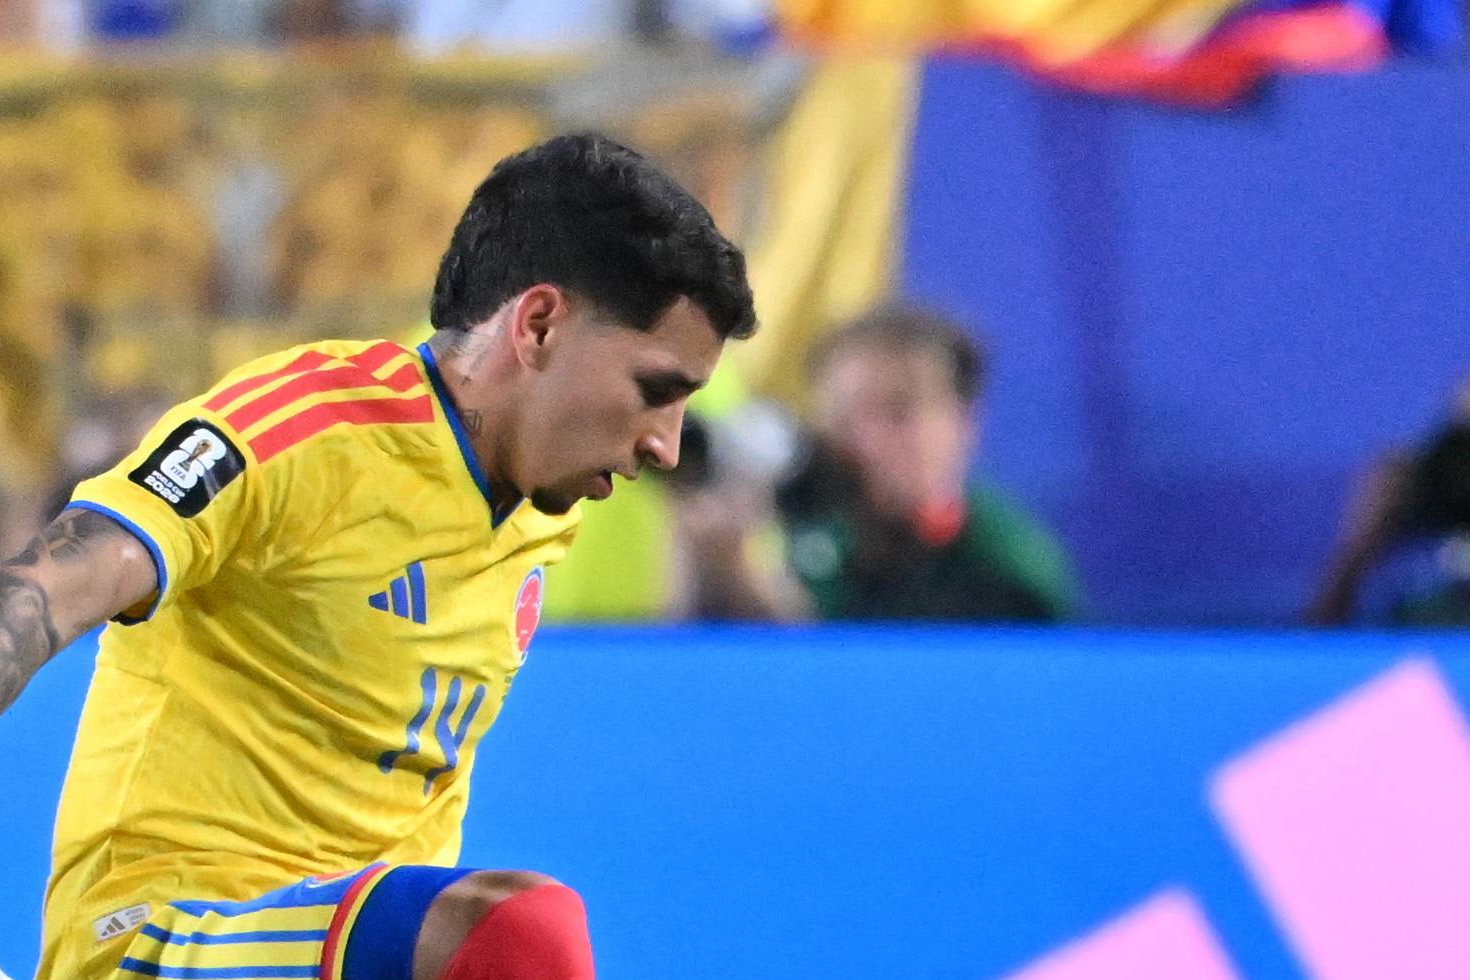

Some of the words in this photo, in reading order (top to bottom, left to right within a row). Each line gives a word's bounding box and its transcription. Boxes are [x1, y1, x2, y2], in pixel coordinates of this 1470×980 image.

[170, 466, 186, 481] FIFA
[144, 475, 180, 504] 2026
[378, 667, 486, 797] 14
